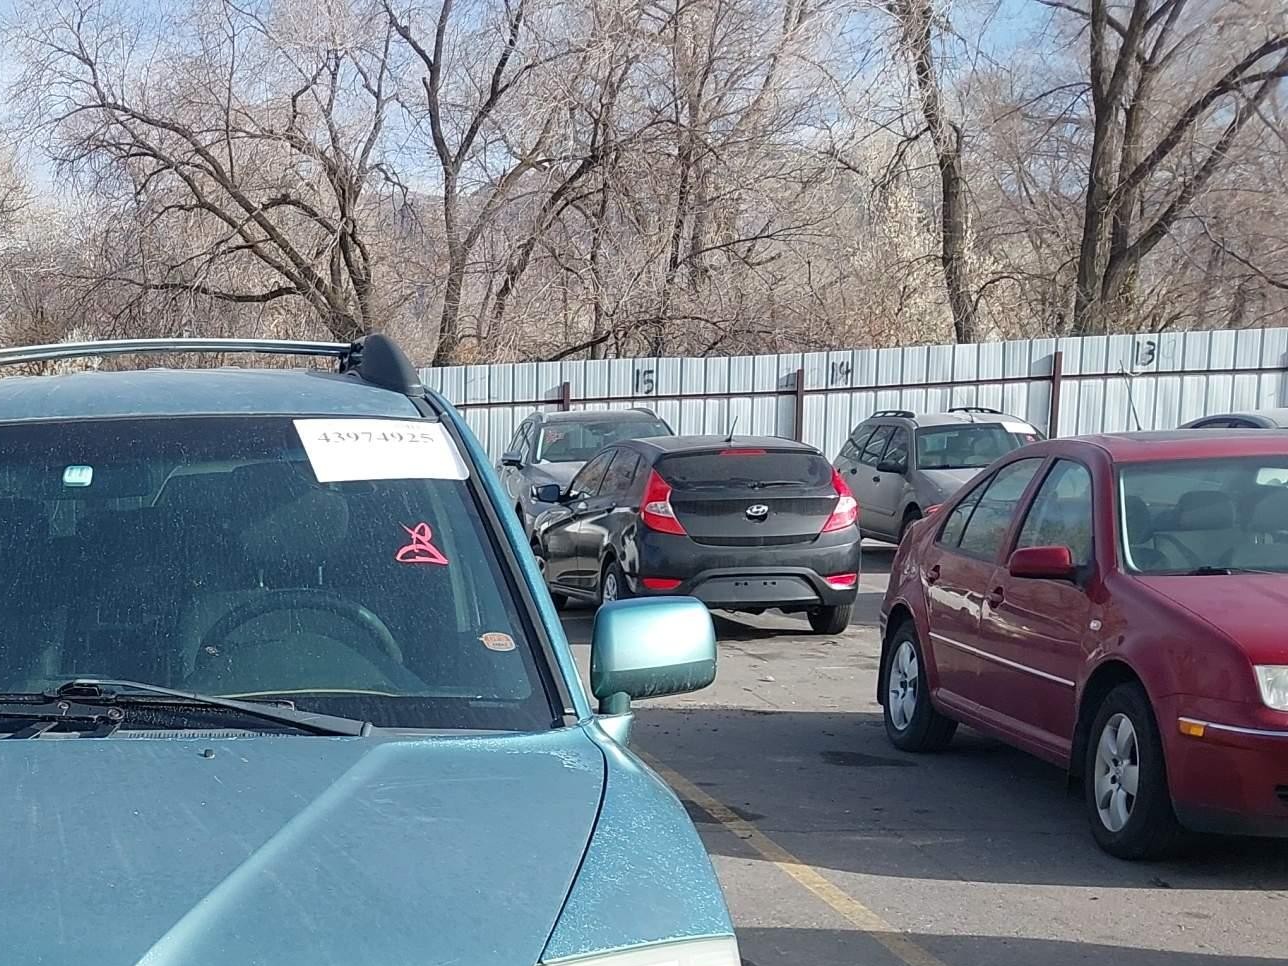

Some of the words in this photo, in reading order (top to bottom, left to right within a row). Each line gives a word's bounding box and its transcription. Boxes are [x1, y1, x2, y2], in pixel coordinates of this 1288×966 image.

[1135, 340, 1156, 367] 13
[634, 368, 655, 395] 15
[830, 360, 852, 386] 14
[317, 431, 435, 444] 43974925
